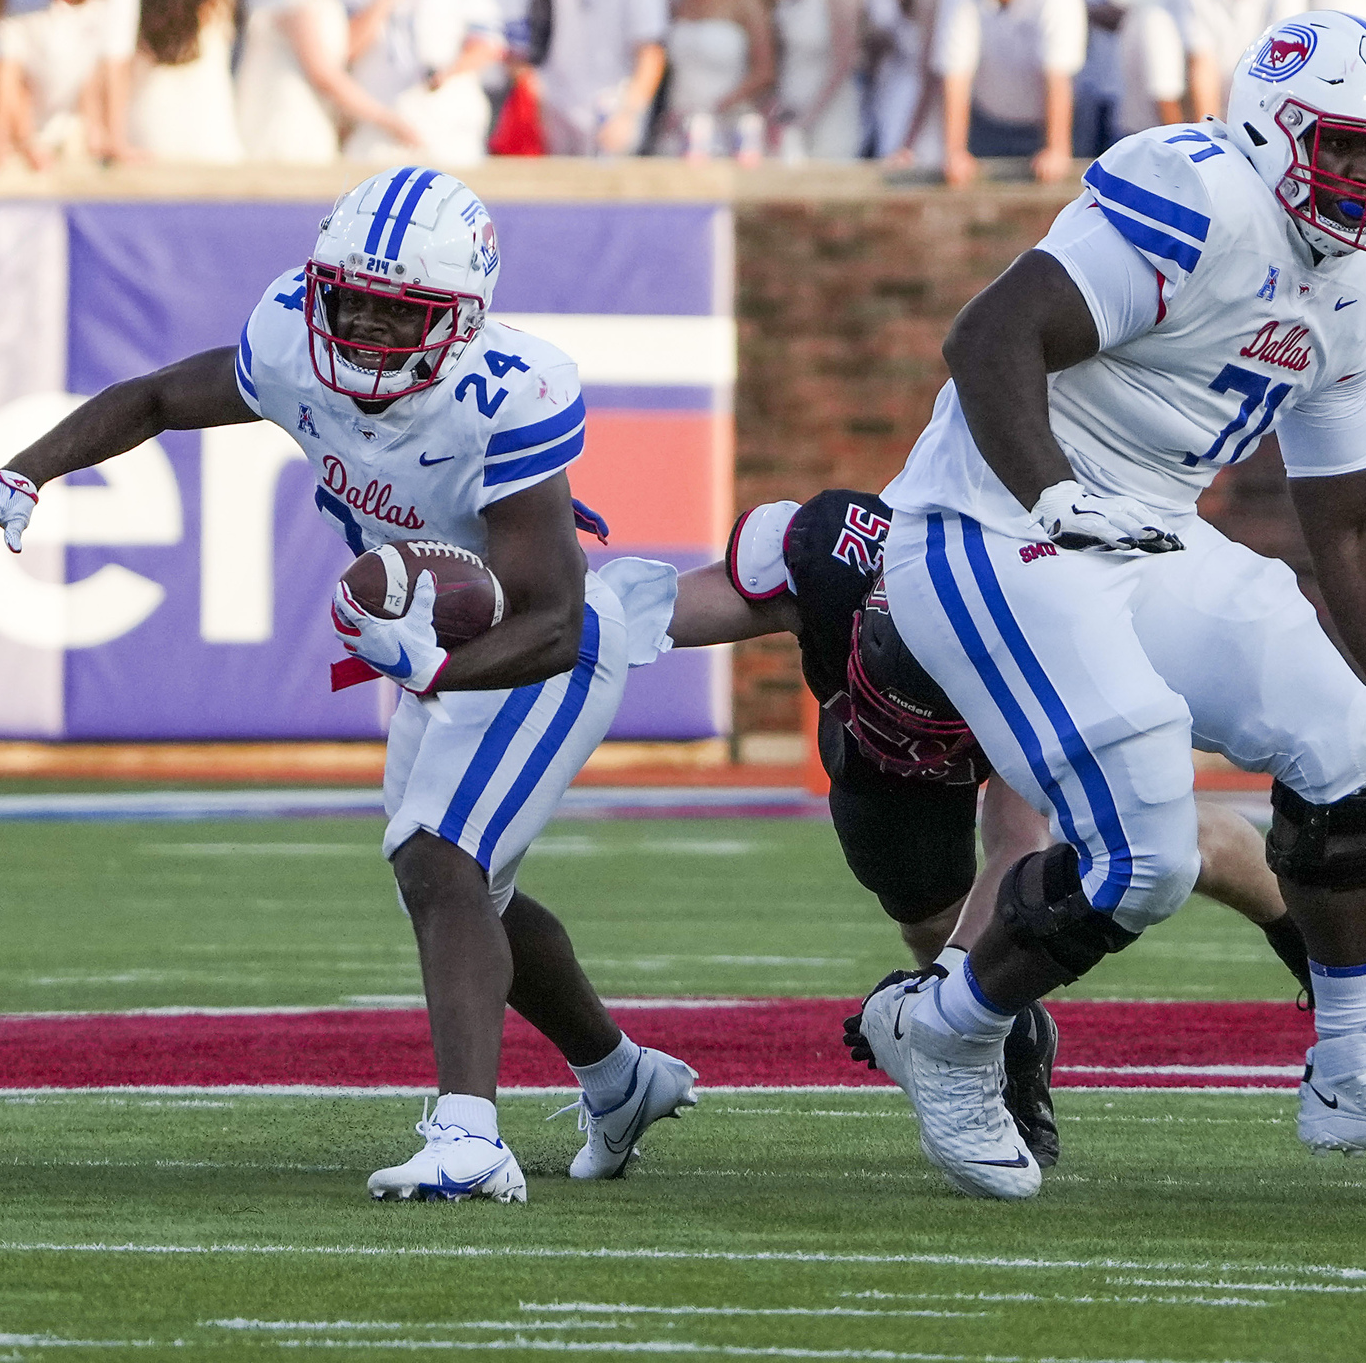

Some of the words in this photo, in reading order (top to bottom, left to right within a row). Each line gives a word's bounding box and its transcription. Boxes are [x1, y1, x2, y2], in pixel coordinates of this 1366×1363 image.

[1164, 128, 1226, 164] 71
[366, 257, 390, 275] 214
[1240, 320, 1311, 372] Dallas
[454, 349, 531, 420] 24
[1181, 362, 1295, 468] 71
[322, 454, 425, 530] Dallas
[1019, 542, 1059, 564] SMU
[387, 593, 403, 607] TE
